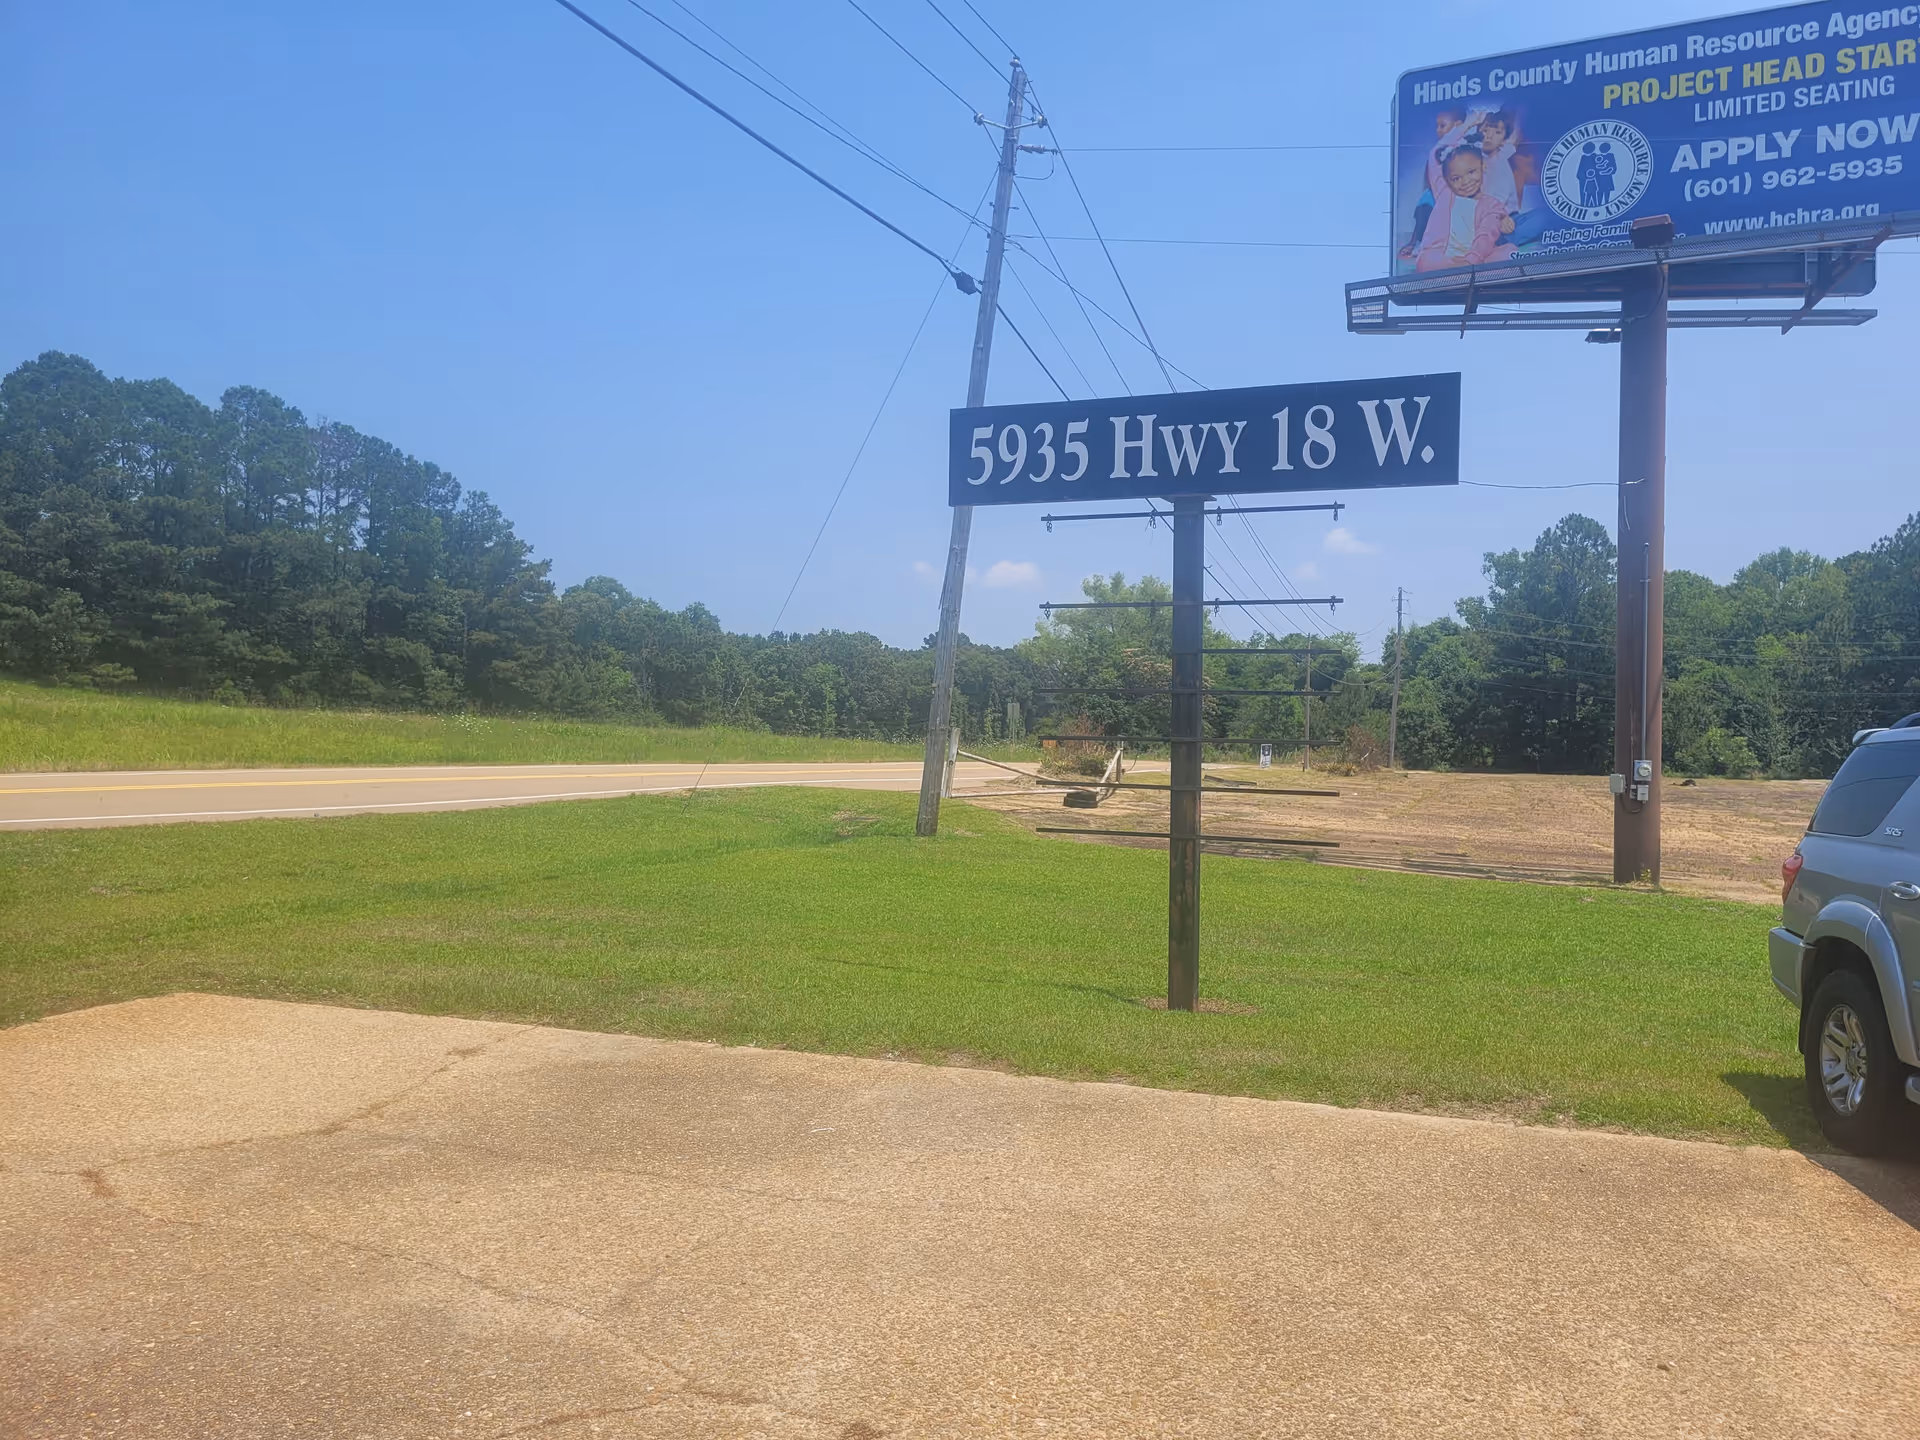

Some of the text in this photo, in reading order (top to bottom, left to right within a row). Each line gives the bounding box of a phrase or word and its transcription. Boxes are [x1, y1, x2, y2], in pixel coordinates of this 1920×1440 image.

[1414, 75, 1481, 105] Hinds
[1489, 59, 1578, 93] County
[1585, 43, 1678, 76] Human
[1687, 21, 1820, 59] Resource
[1603, 66, 1733, 109] PROJECT
[1743, 52, 1825, 88] HEAD
[1694, 75, 1895, 123] LIMITED SEATING
[1545, 123, 1650, 220] HINDS COUNTY HUMAN RESOURCE AGENCY
[1670, 113, 1920, 173] APPLY NOW
[1684, 155, 1903, 202] (601) 962-5935
[1542, 227, 1592, 245] Helping
[1593, 220, 1633, 238] Famili
[1704, 203, 1880, 235] www.hchra.org
[967, 418, 1089, 485] 5935
[1271, 404, 1336, 471] 18
[1357, 396, 1435, 467] W.
